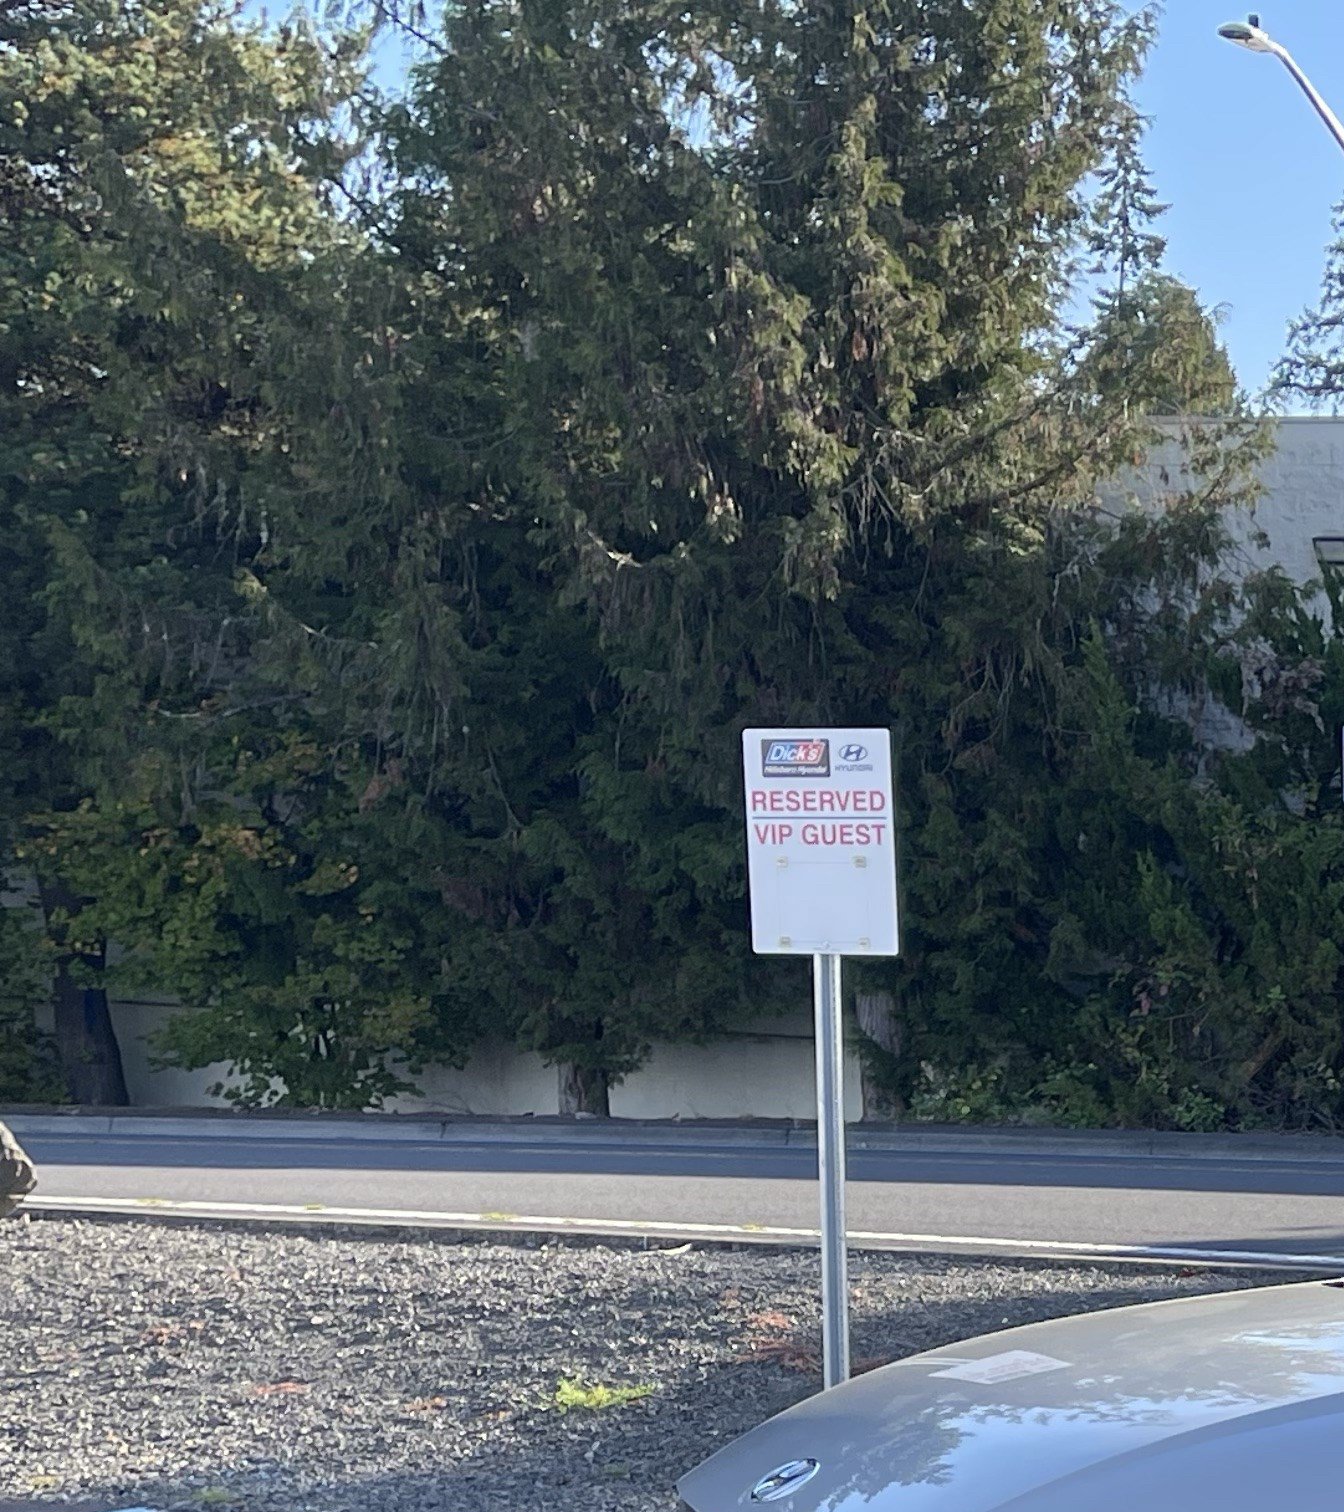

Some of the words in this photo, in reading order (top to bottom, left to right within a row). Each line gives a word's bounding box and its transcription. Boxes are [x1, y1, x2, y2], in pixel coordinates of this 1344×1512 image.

[751, 790, 886, 812] RESERVED
[754, 824, 792, 845] VIP
[801, 823, 885, 846] GUEST
